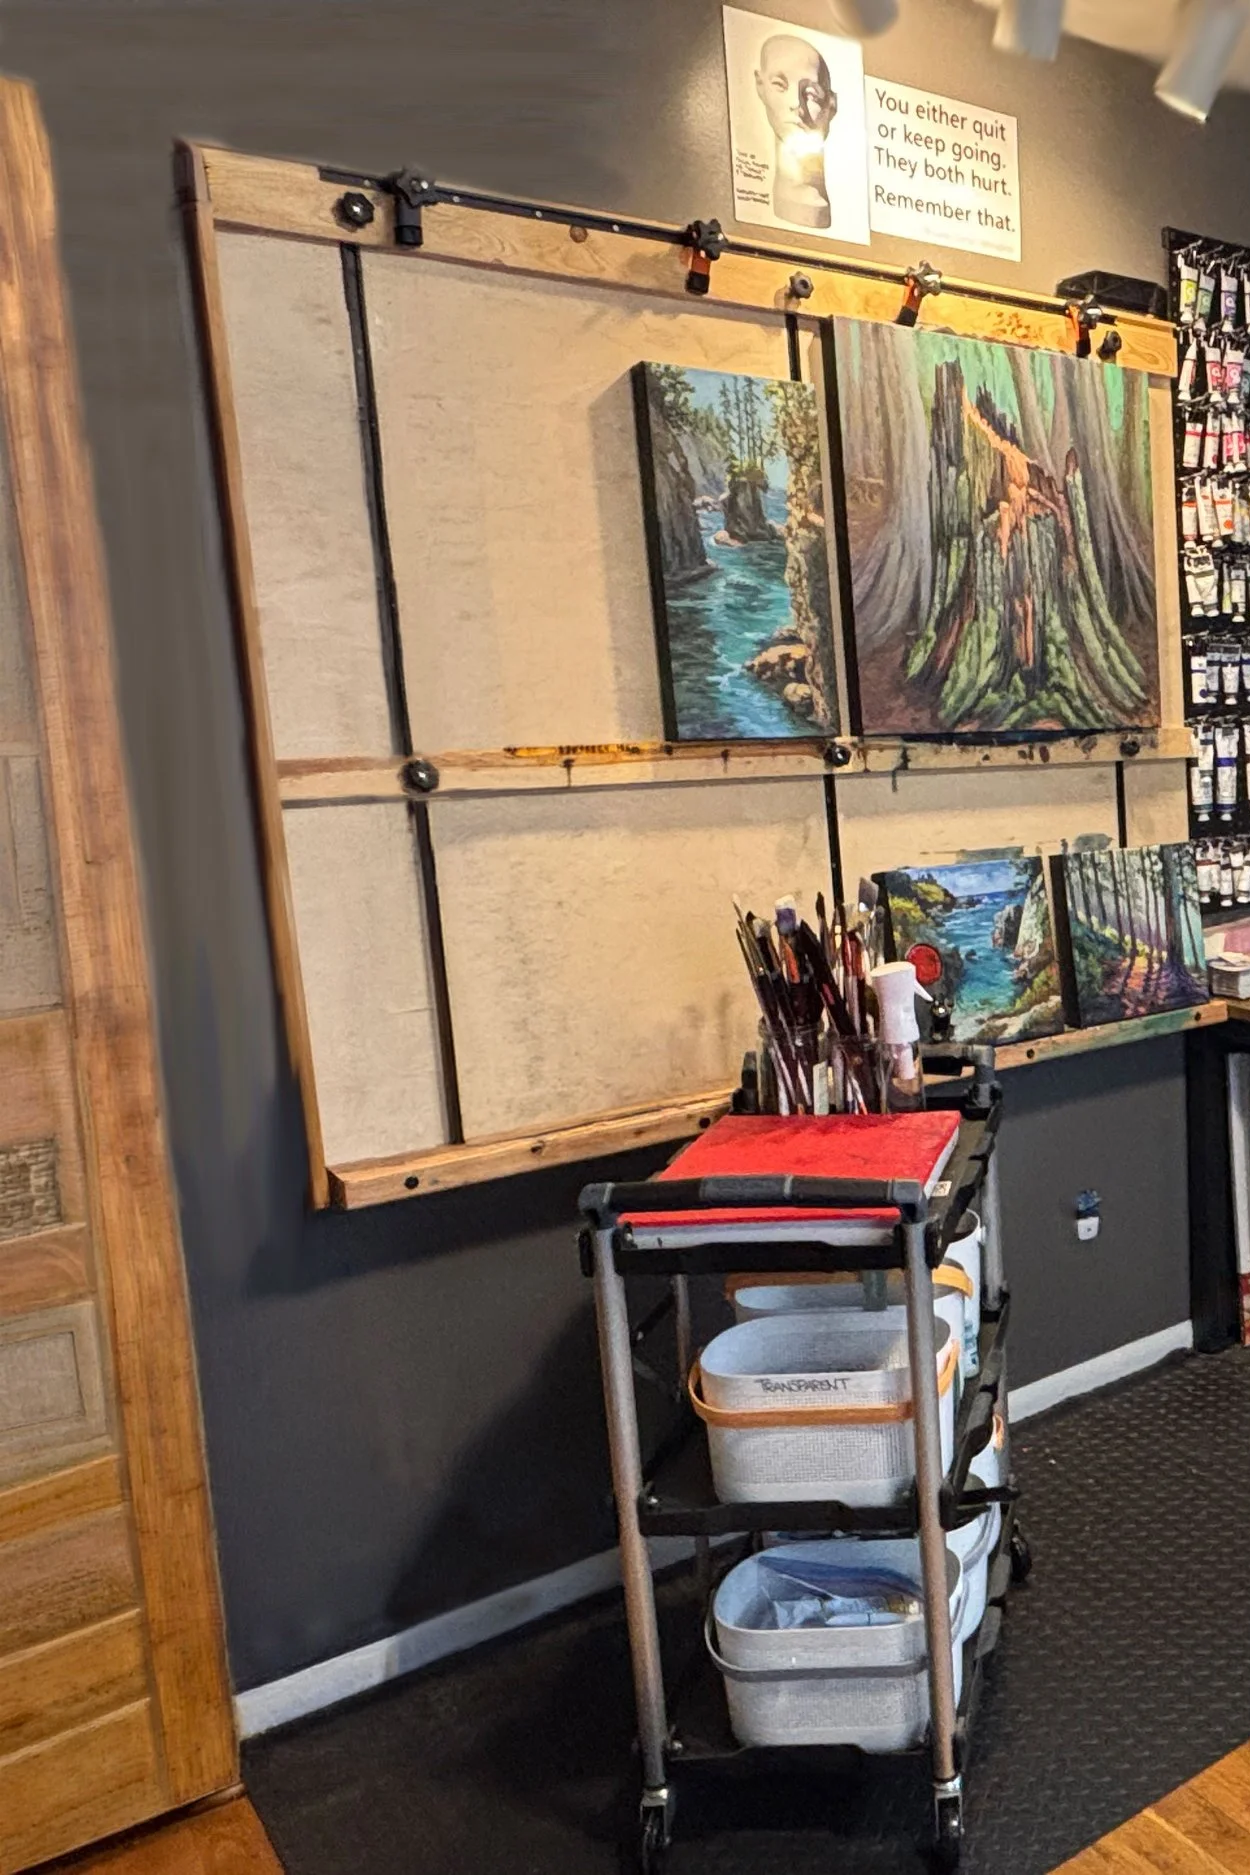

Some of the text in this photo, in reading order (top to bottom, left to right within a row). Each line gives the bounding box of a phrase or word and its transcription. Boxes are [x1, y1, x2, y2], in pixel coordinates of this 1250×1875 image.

[875, 88, 1006, 142] You either quit
[874, 145, 1012, 196] They both hurt.
[877, 123, 1007, 171] or keep going.
[874, 184, 1015, 232] Remember that.
[754, 1377, 851, 1393] TRANSPARENT
